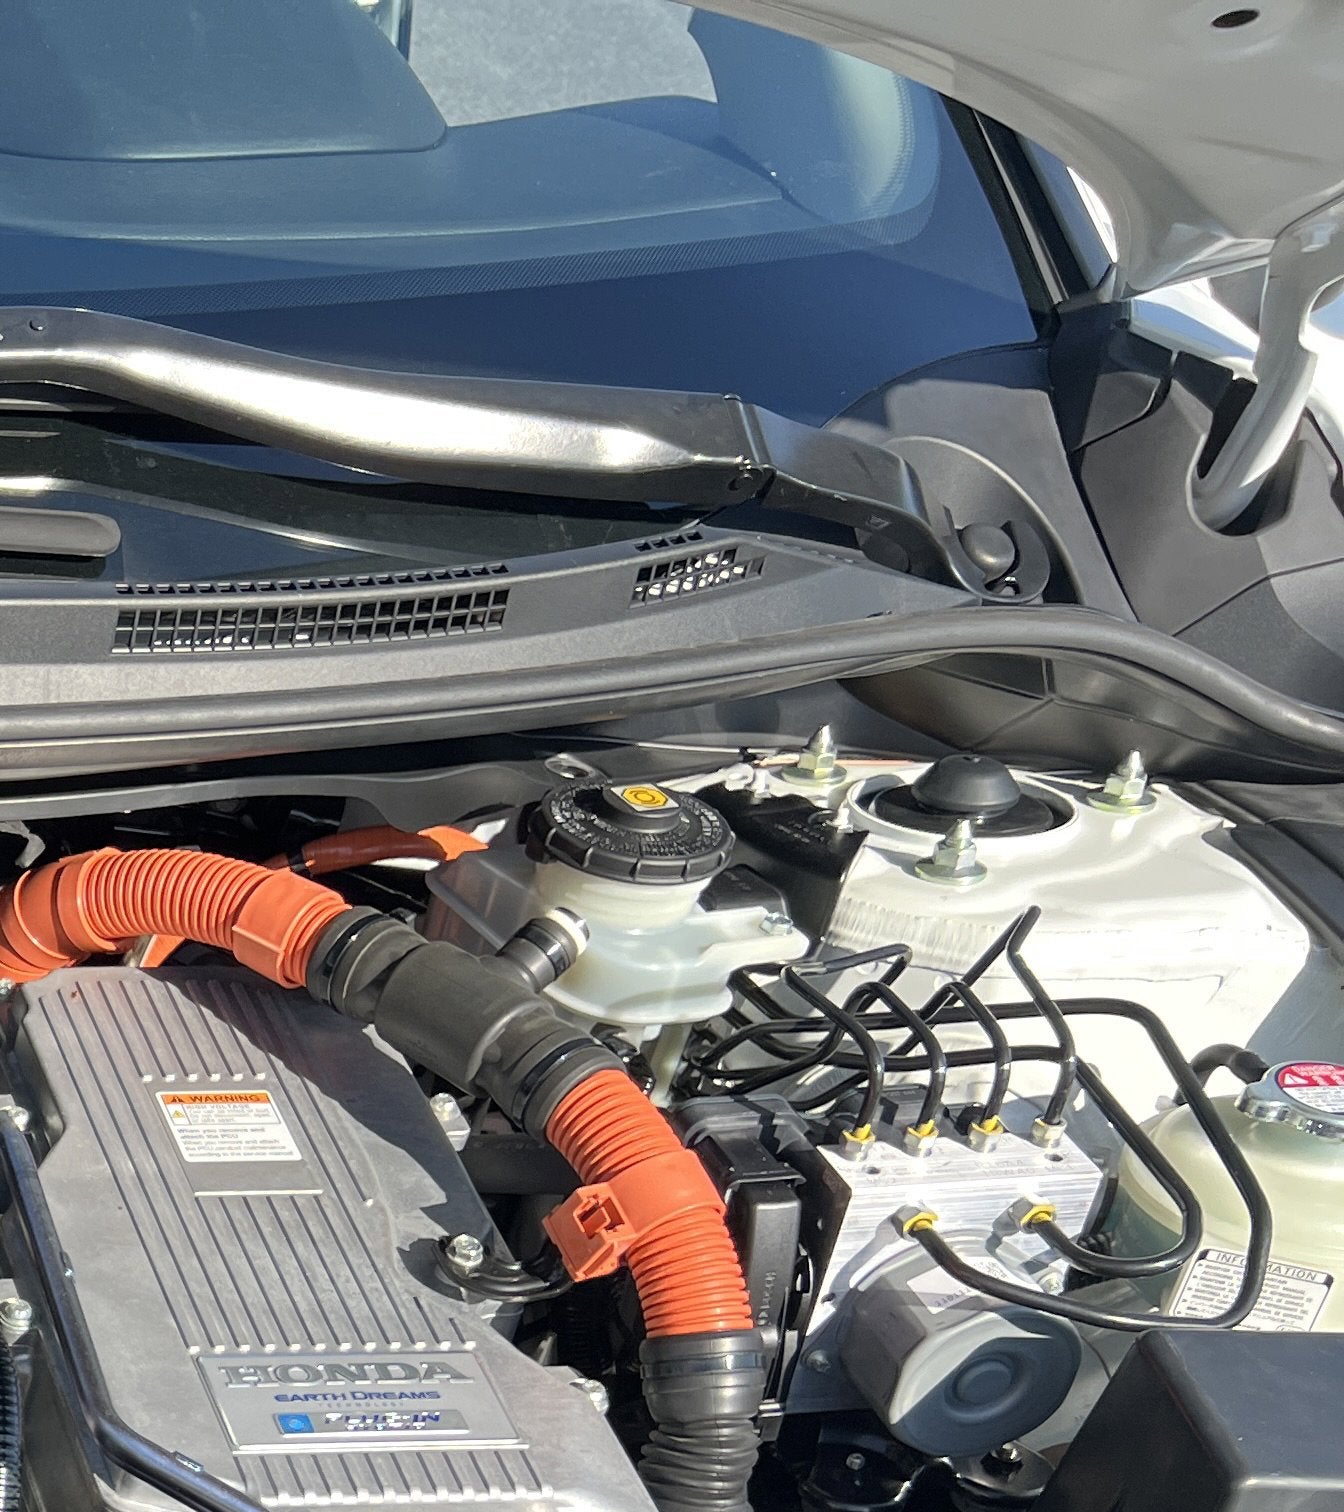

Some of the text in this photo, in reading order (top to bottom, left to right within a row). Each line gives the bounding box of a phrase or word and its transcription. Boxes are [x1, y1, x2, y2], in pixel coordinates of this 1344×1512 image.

[190, 1094, 261, 1103] WARNING
[217, 1363, 474, 1388] HONDA
[273, 1391, 441, 1402] EARTH DREAMS
